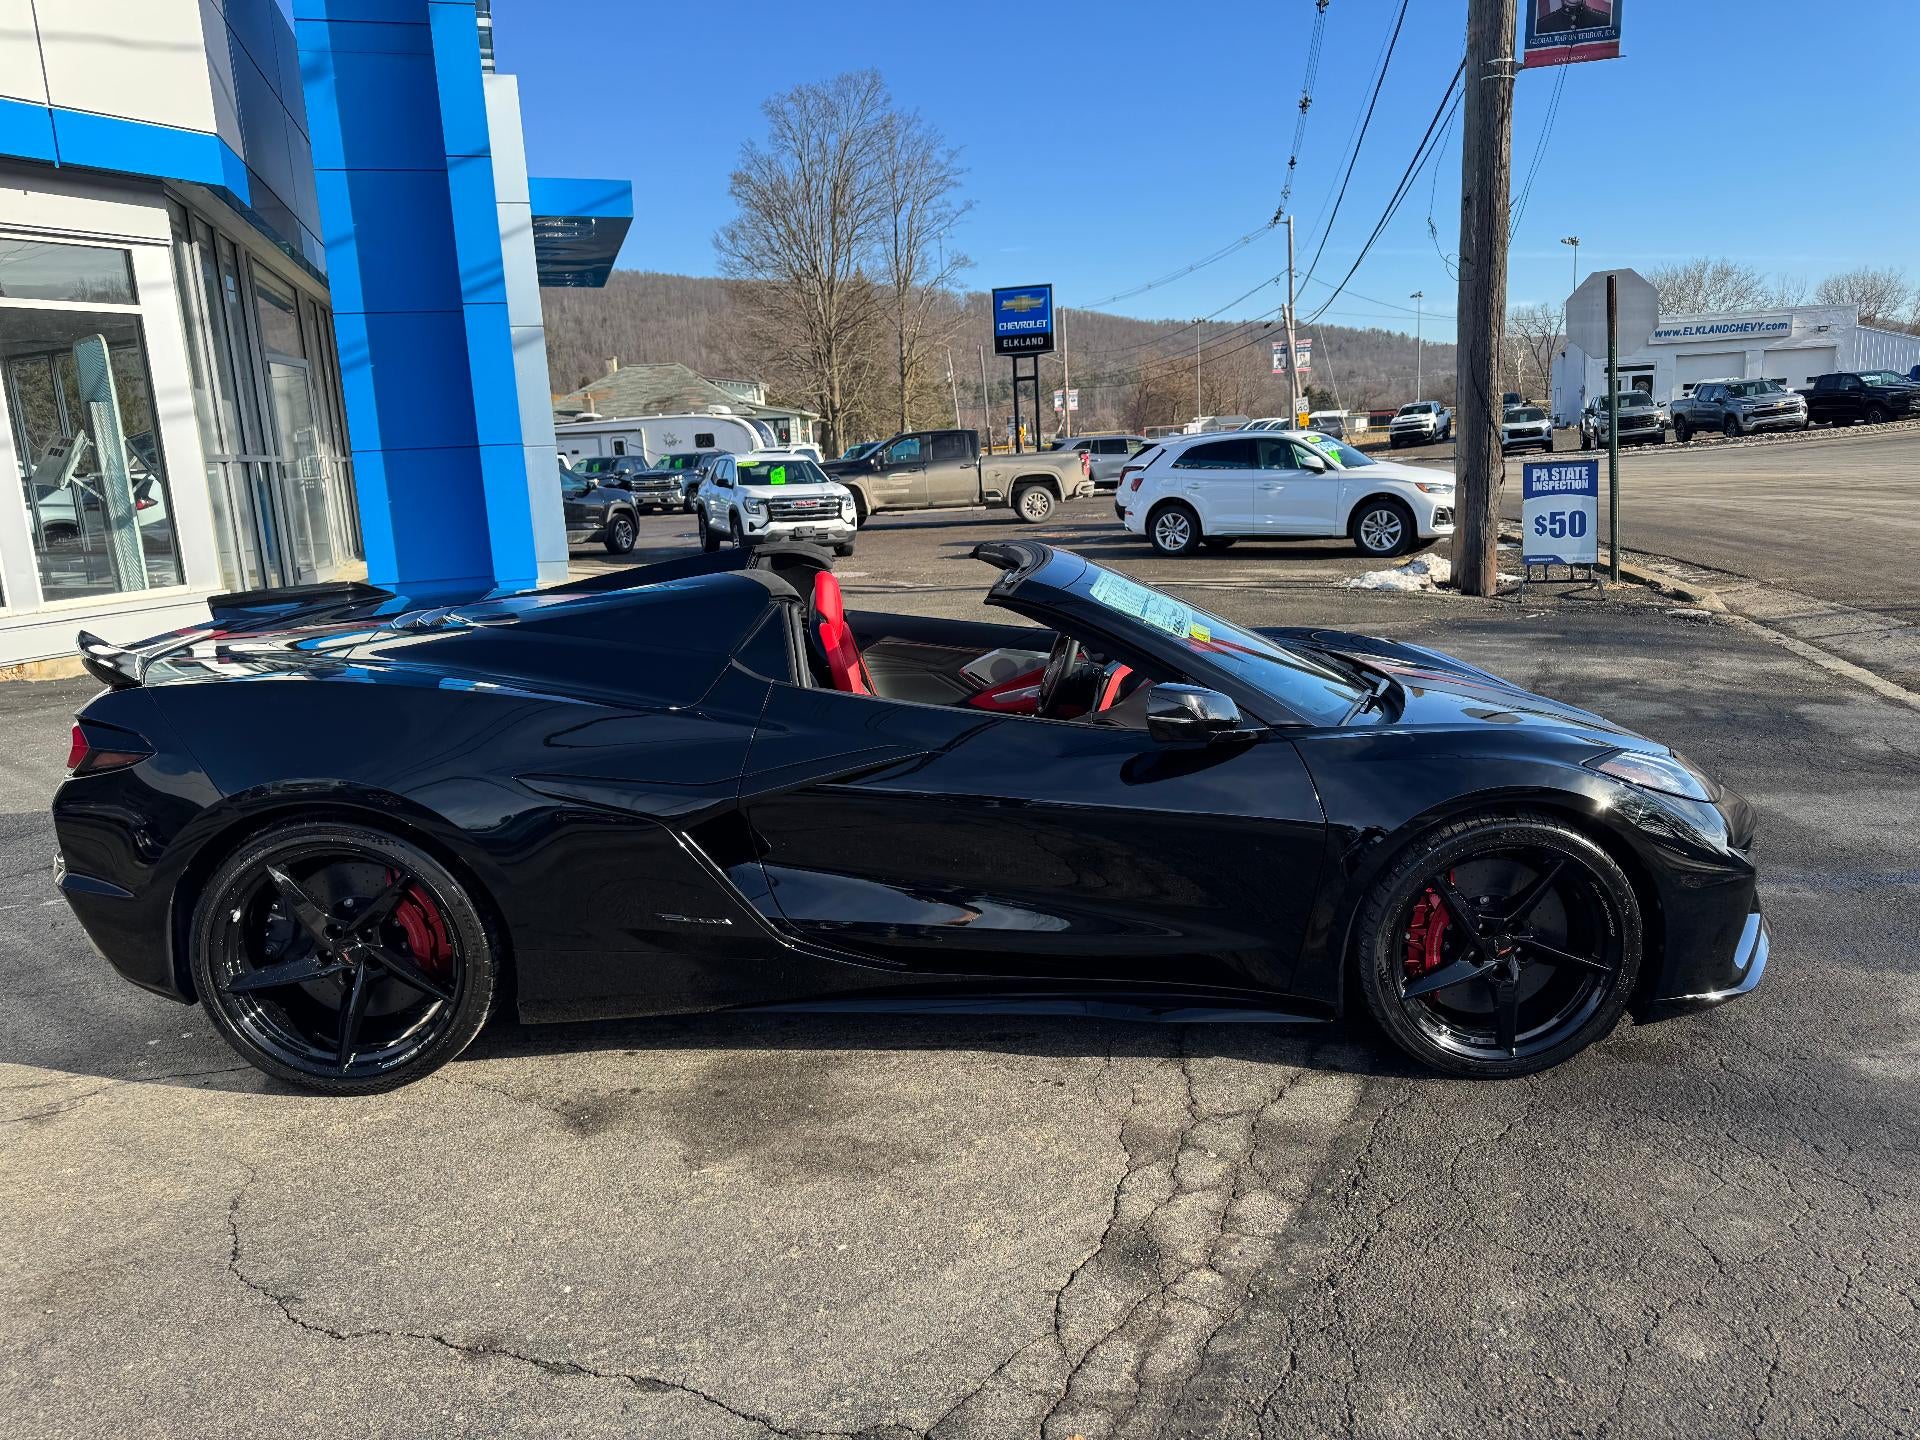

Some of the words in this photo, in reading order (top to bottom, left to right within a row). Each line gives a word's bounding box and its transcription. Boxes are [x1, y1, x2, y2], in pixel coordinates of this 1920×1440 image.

[1529, 36, 1553, 45] GLOBAL
[999, 320, 1048, 330] CHEVROLET
[1654, 322, 1788, 338] www.ELKLANDCHEVY.com
[1003, 337, 1044, 348] ELKLAND
[1532, 468, 1549, 481] PA
[1551, 466, 1589, 480] STATE
[1532, 479, 1589, 491] INSPECTION
[1534, 510, 1587, 539] $50
